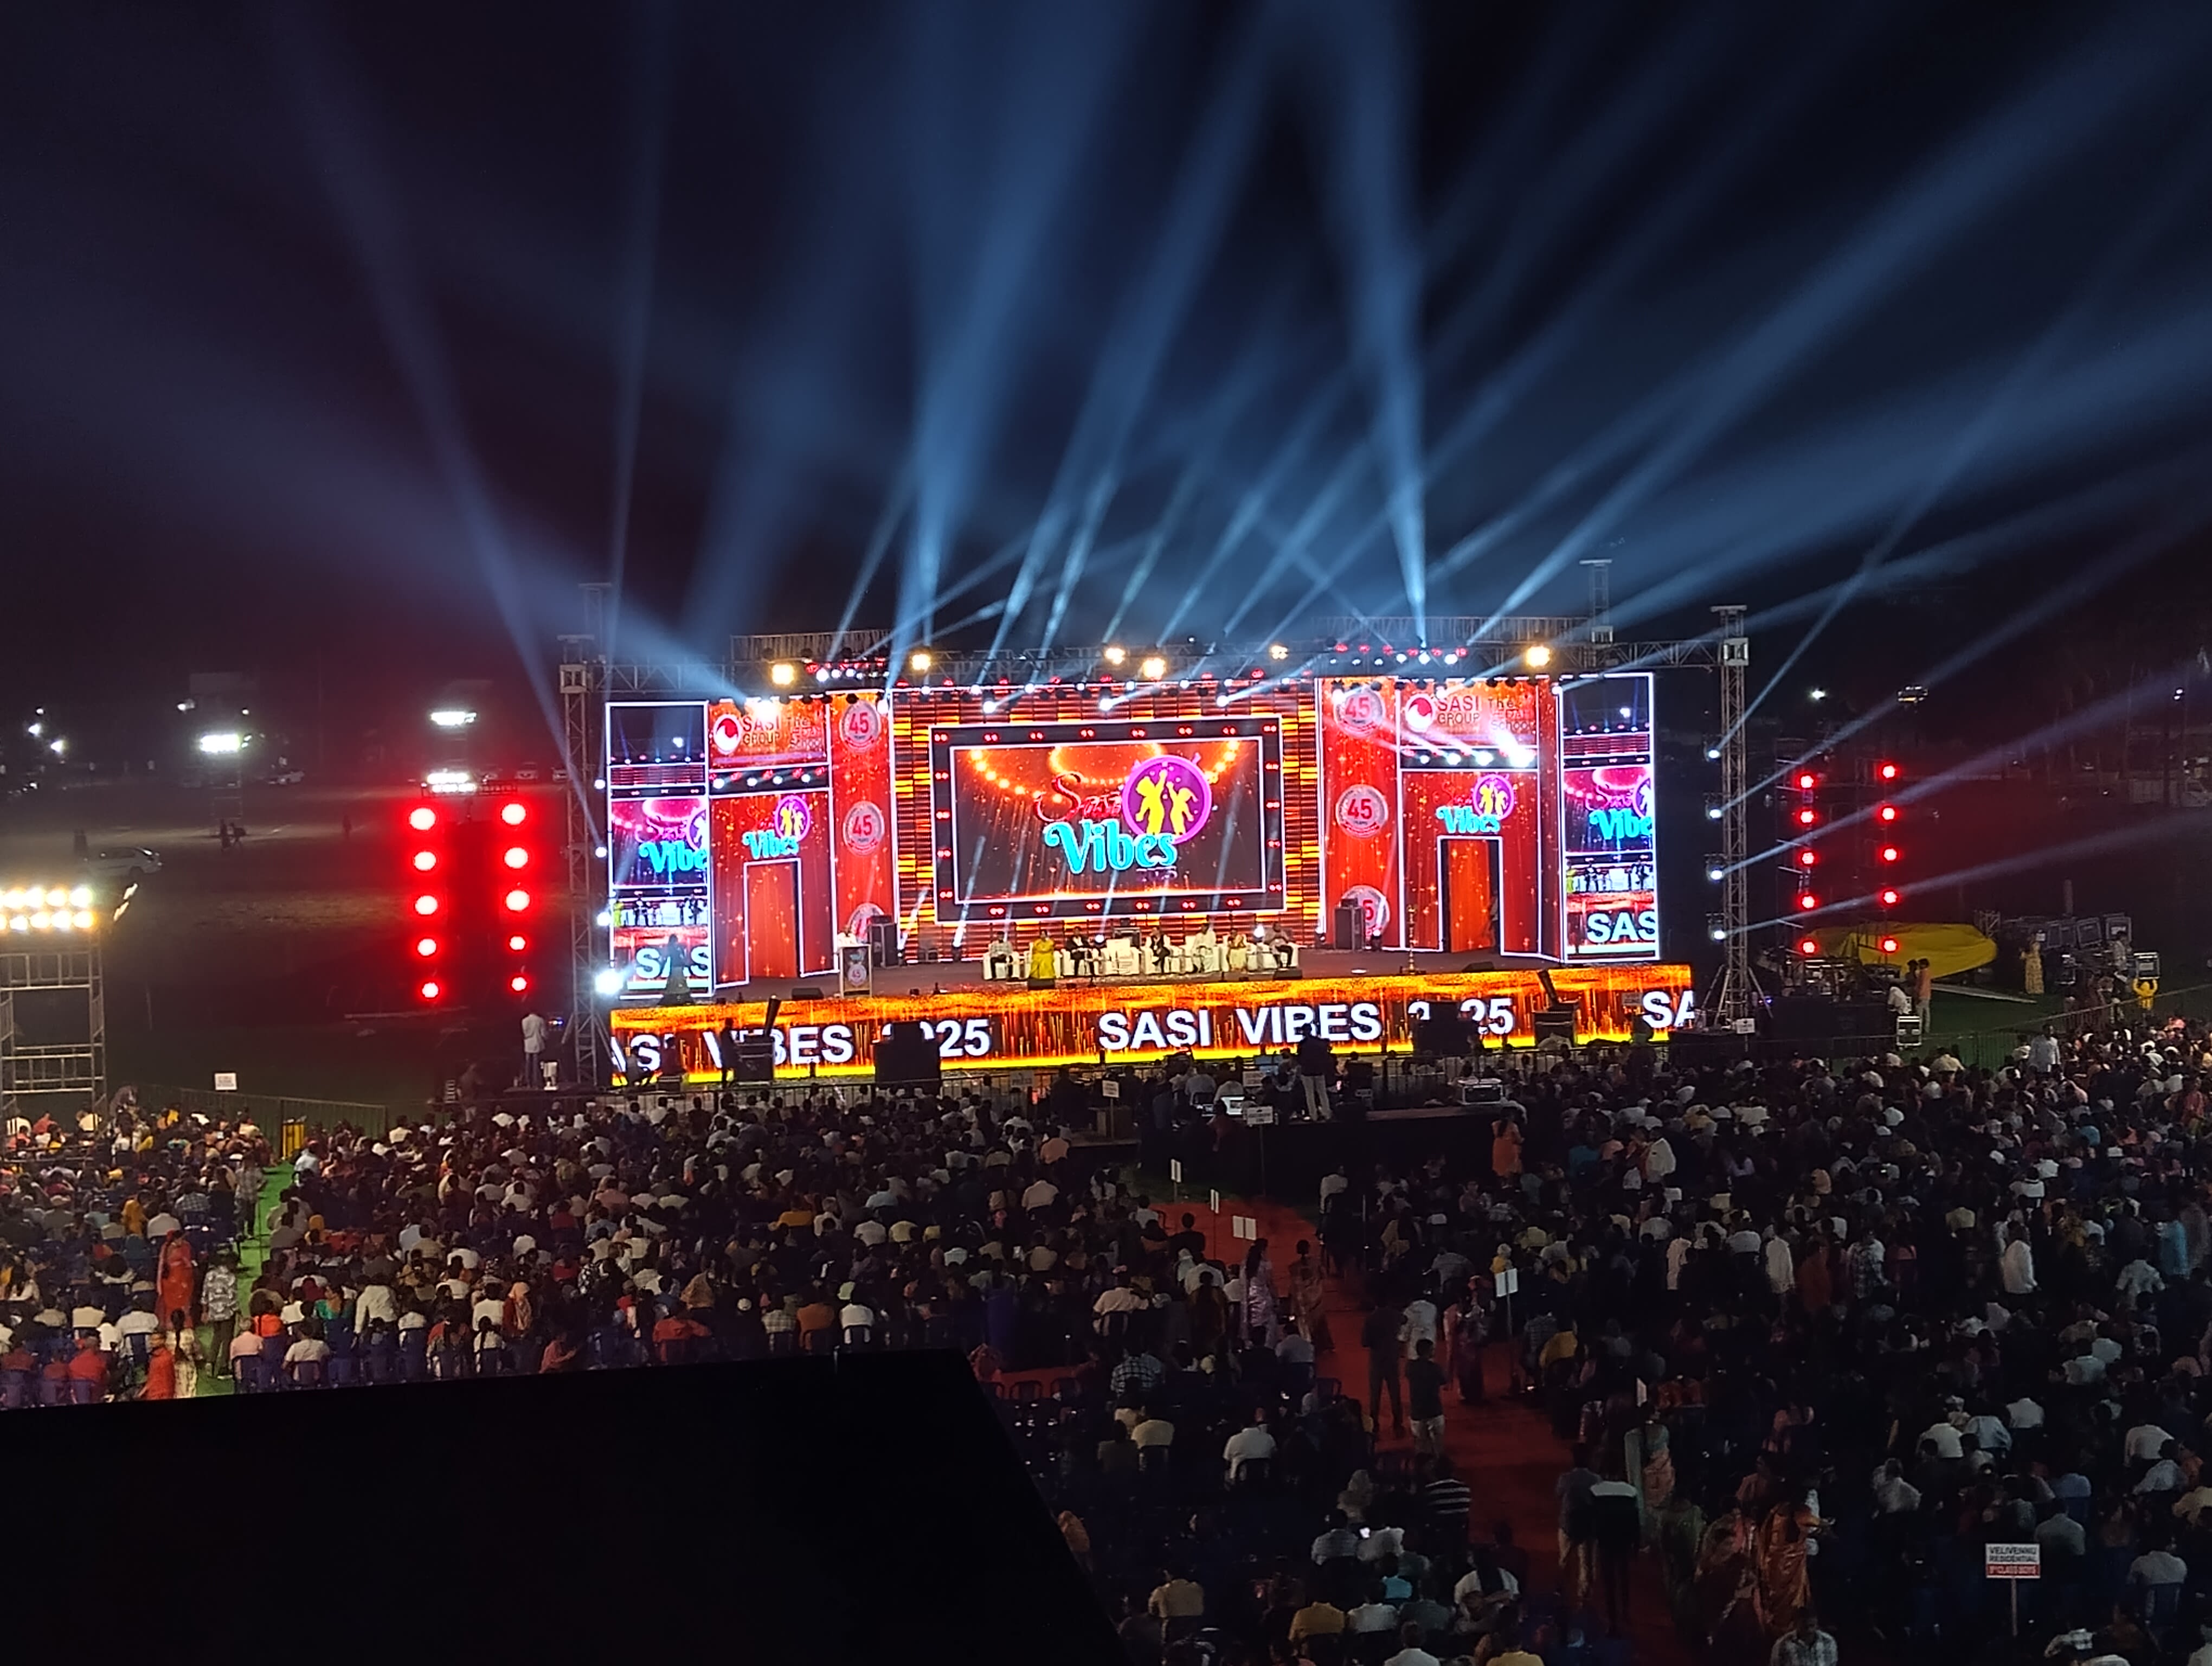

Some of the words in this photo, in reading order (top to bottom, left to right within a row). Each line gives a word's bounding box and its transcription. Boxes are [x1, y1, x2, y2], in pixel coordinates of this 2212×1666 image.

[1345, 697, 1371, 717] 45
[1437, 696, 1480, 712] SASI
[849, 712, 869, 734] 45
[1437, 713, 1480, 725] GROUP
[742, 731, 781, 745] GROUP
[1348, 798, 1372, 819] 45
[853, 815, 872, 836] 45
[1435, 805, 1501, 834] Vibes
[742, 829, 800, 860] Vibes
[1043, 818, 1178, 874] Vibes
[1098, 1009, 1211, 1050] SASI
[1236, 1002, 1382, 1045] VIBES
